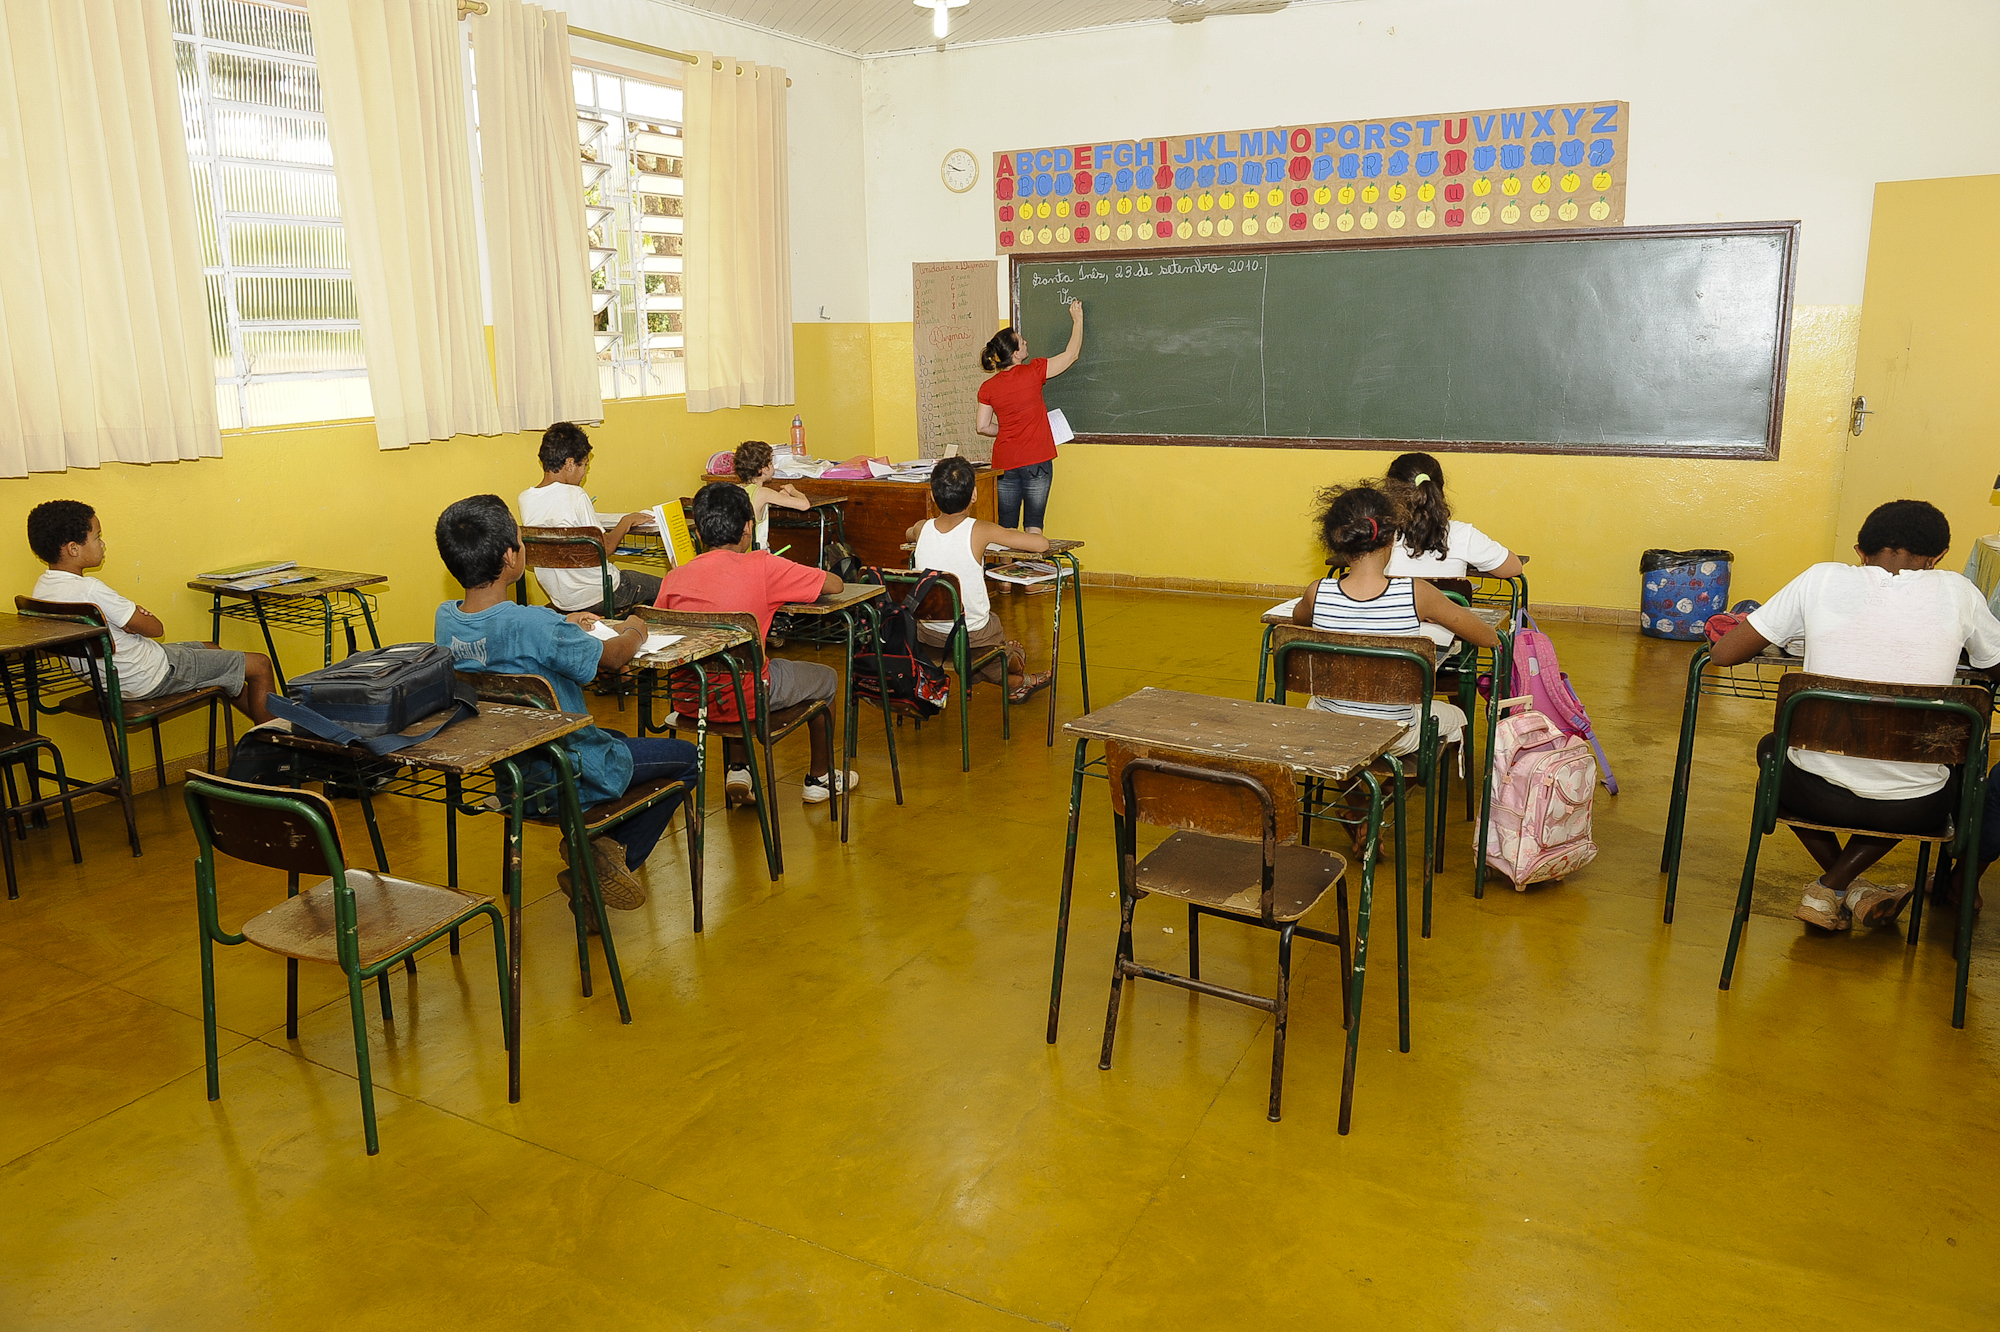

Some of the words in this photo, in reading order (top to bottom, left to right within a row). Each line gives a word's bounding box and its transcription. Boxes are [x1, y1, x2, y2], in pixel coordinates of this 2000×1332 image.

[997, 154, 1014, 178] A
[1016, 152, 1034, 175] B
[1034, 149, 1053, 172] C
[1054, 148, 1072, 172] D
[1074, 146, 1092, 170] E
[1094, 144, 1113, 169] F
[1113, 143, 1133, 167] G
[1135, 142, 1154, 166] H
[1160, 141, 1167, 164] I
[1174, 139, 1194, 163] J
[1195, 135, 1215, 161] K
[1217, 134, 1237, 158] L
[1240, 131, 1263, 157] M
[1266, 130, 1287, 155] N
[1290, 128, 1311, 153] O
[1315, 127, 1336, 153] P
[1338, 125, 1360, 149] Q
[1364, 124, 1385, 150] R
[1389, 122, 1413, 147] S
[1416, 120, 1439, 146] T
[1444, 118, 1467, 144] U
[1472, 115, 1495, 142] V
[1501, 112, 1525, 139] W
[1531, 109, 1555, 137] X
[1562, 108, 1586, 135] Y
[1591, 105, 1618, 133] Z
[1114, 265, 1133, 278] 23
[1133, 262, 1153, 277] de
[1158, 258, 1225, 276] setembro
[697, 706, 708, 773] NATALY
